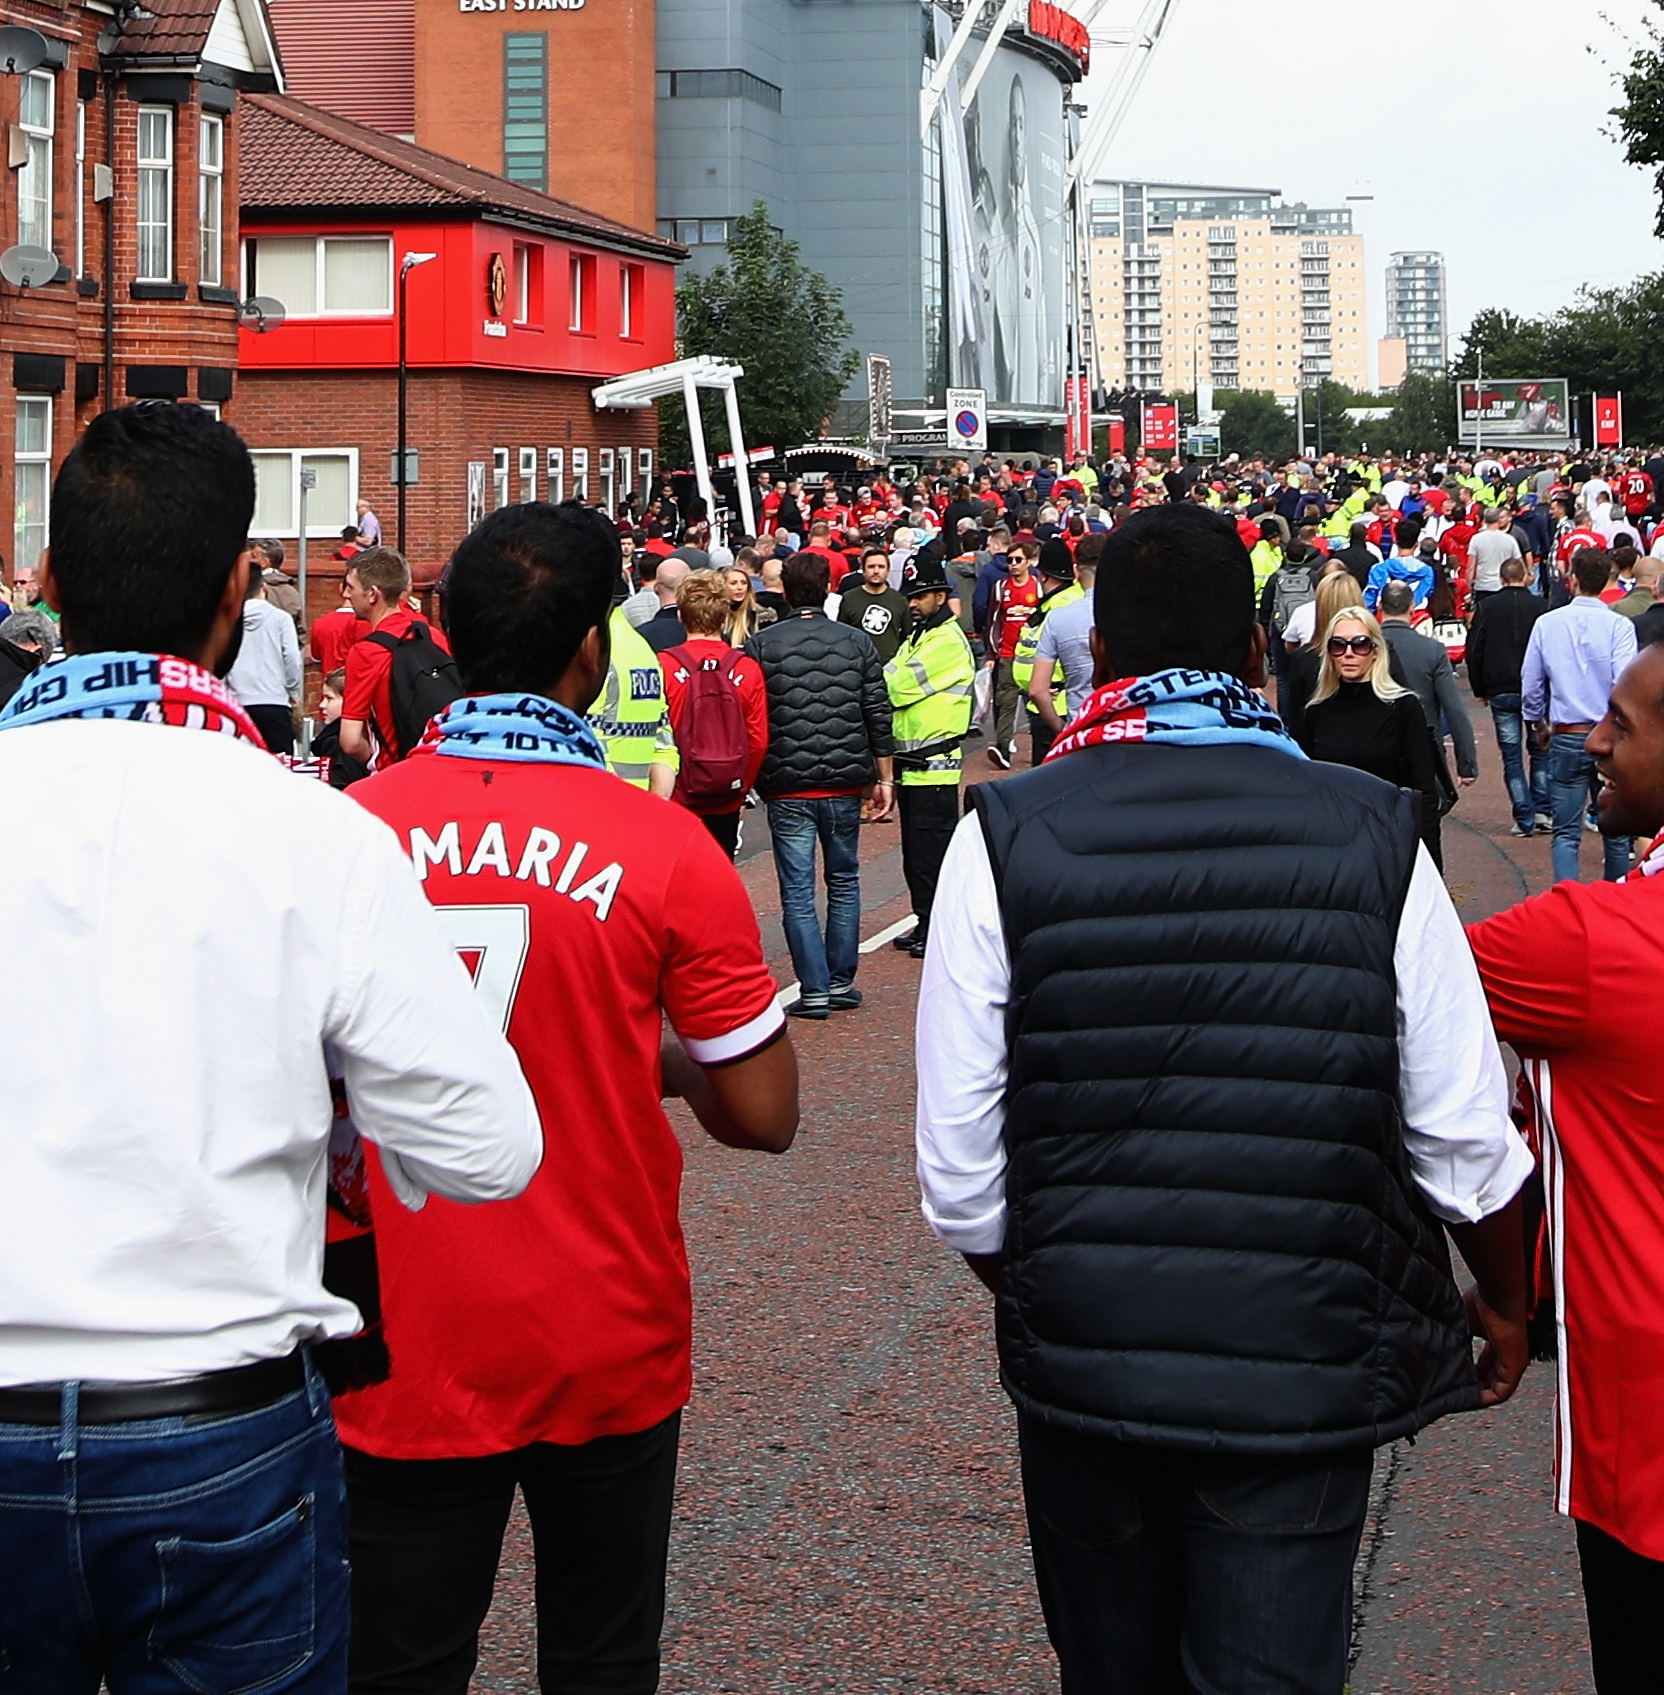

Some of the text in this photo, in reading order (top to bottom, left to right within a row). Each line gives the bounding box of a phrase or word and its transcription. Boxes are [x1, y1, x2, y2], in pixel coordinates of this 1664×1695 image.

[949, 390, 983, 399] Controlled
[954, 399, 979, 408] ZONE
[1627, 479, 1645, 495] 20
[409, 821, 624, 922] MARIA
[434, 903, 530, 1035] 7
